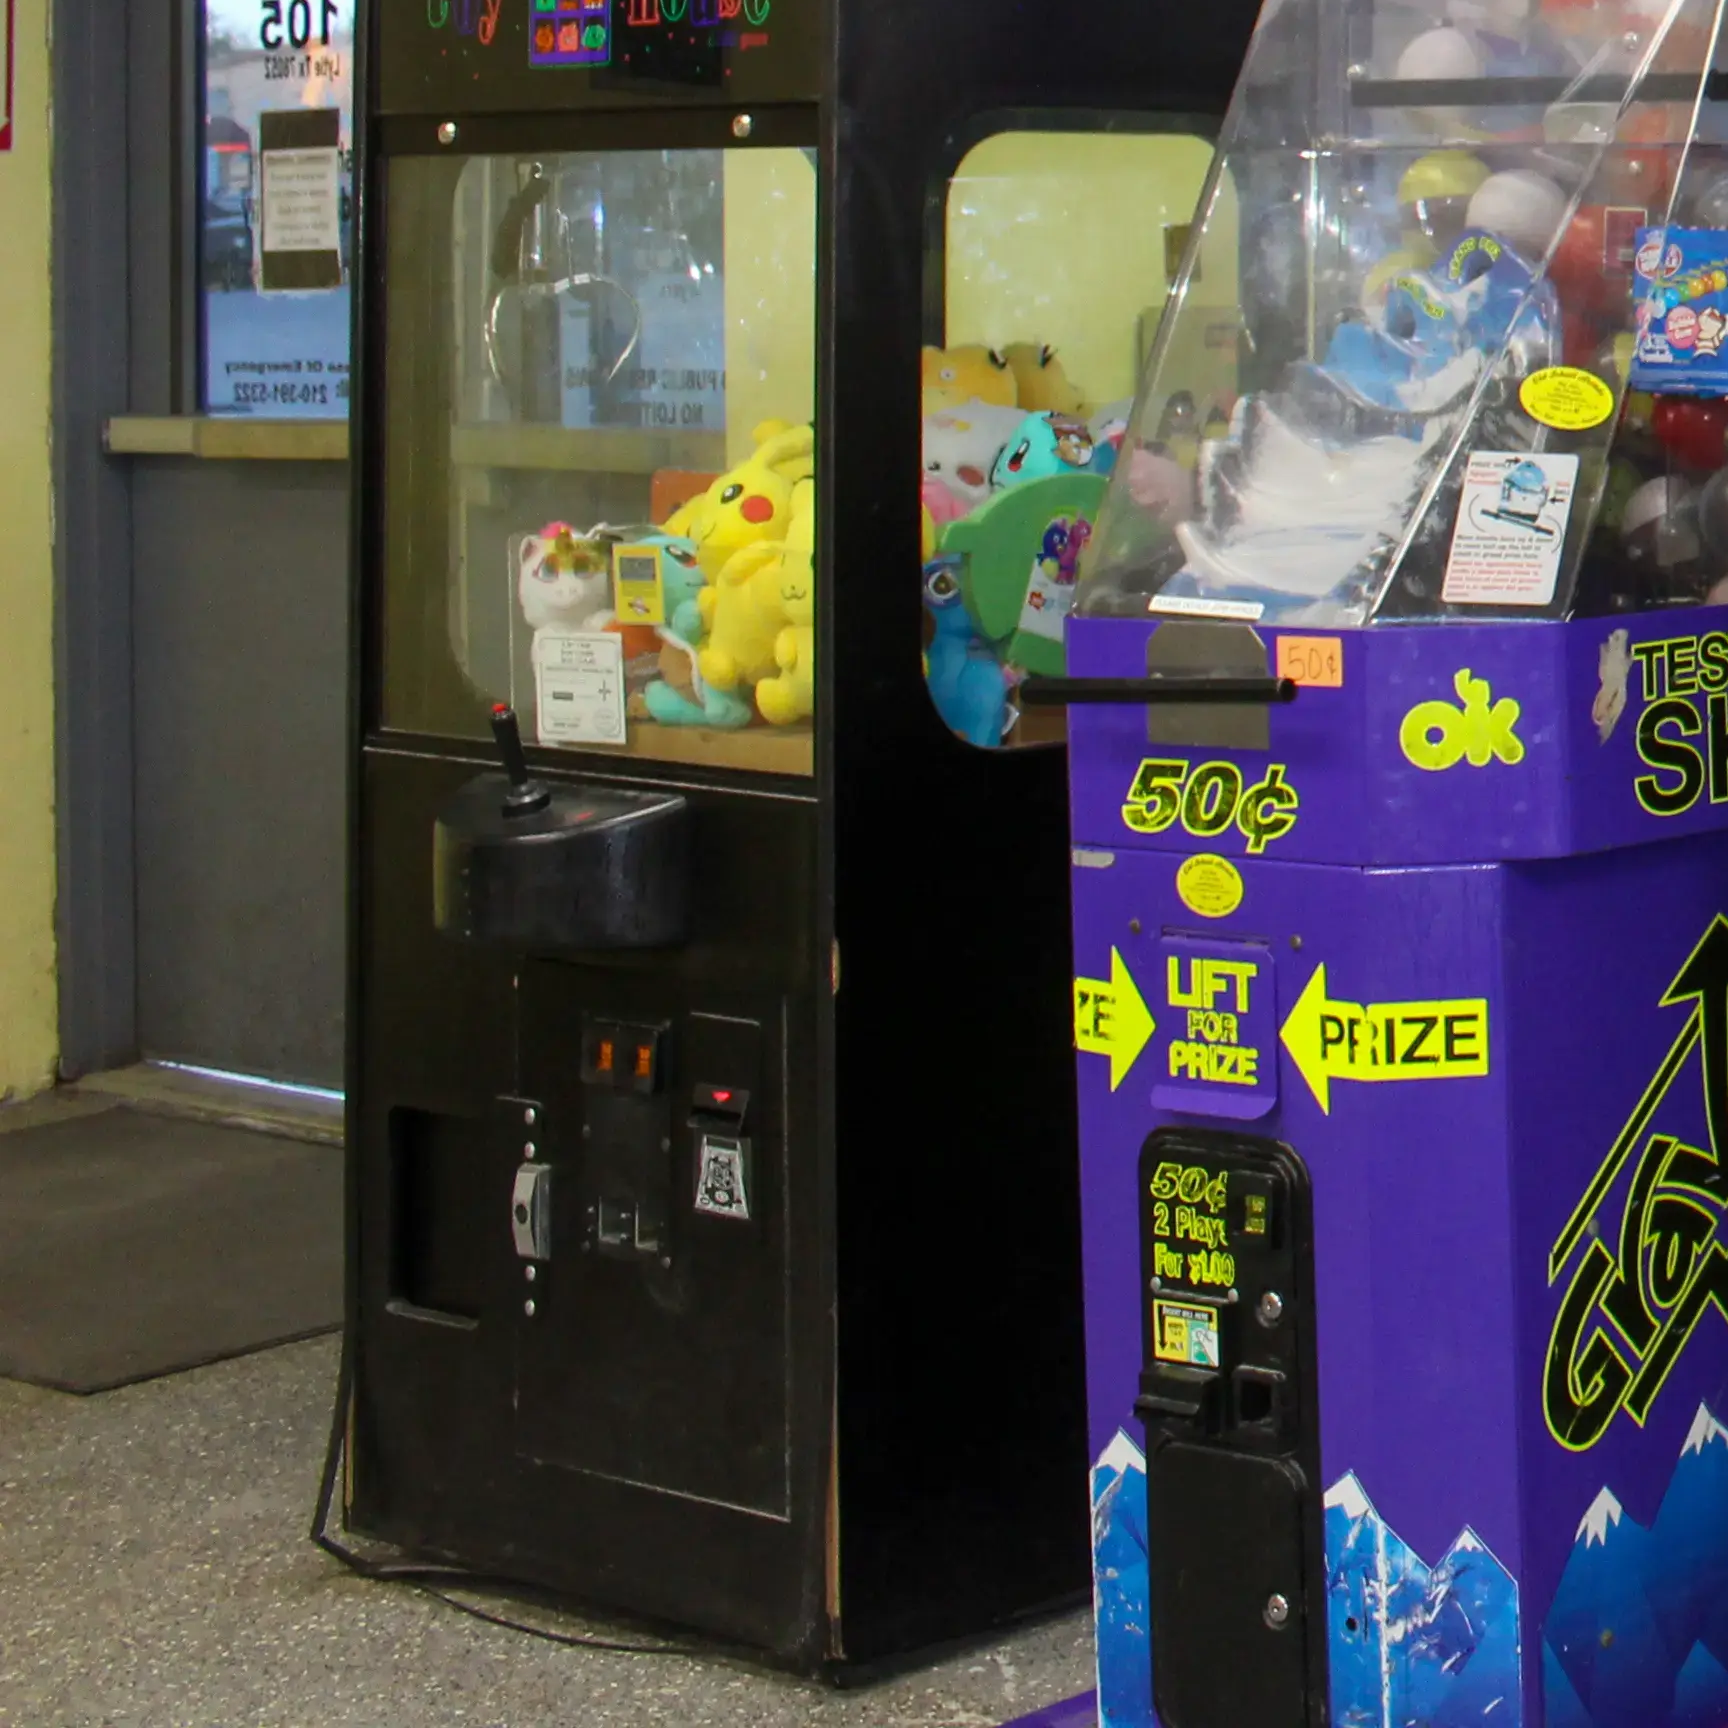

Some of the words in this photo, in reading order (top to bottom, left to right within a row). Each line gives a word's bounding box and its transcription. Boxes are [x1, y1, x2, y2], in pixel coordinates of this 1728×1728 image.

[1121, 757, 1299, 856] 50¢
[1166, 955, 1260, 1014] LIFT
[1187, 1010, 1238, 1046] FOR
[1321, 1011, 1481, 1067] PRIZE
[1168, 1041, 1260, 1087] PRIZE
[1153, 1202, 1170, 1236] 2
[1153, 1242, 1183, 1279] For
